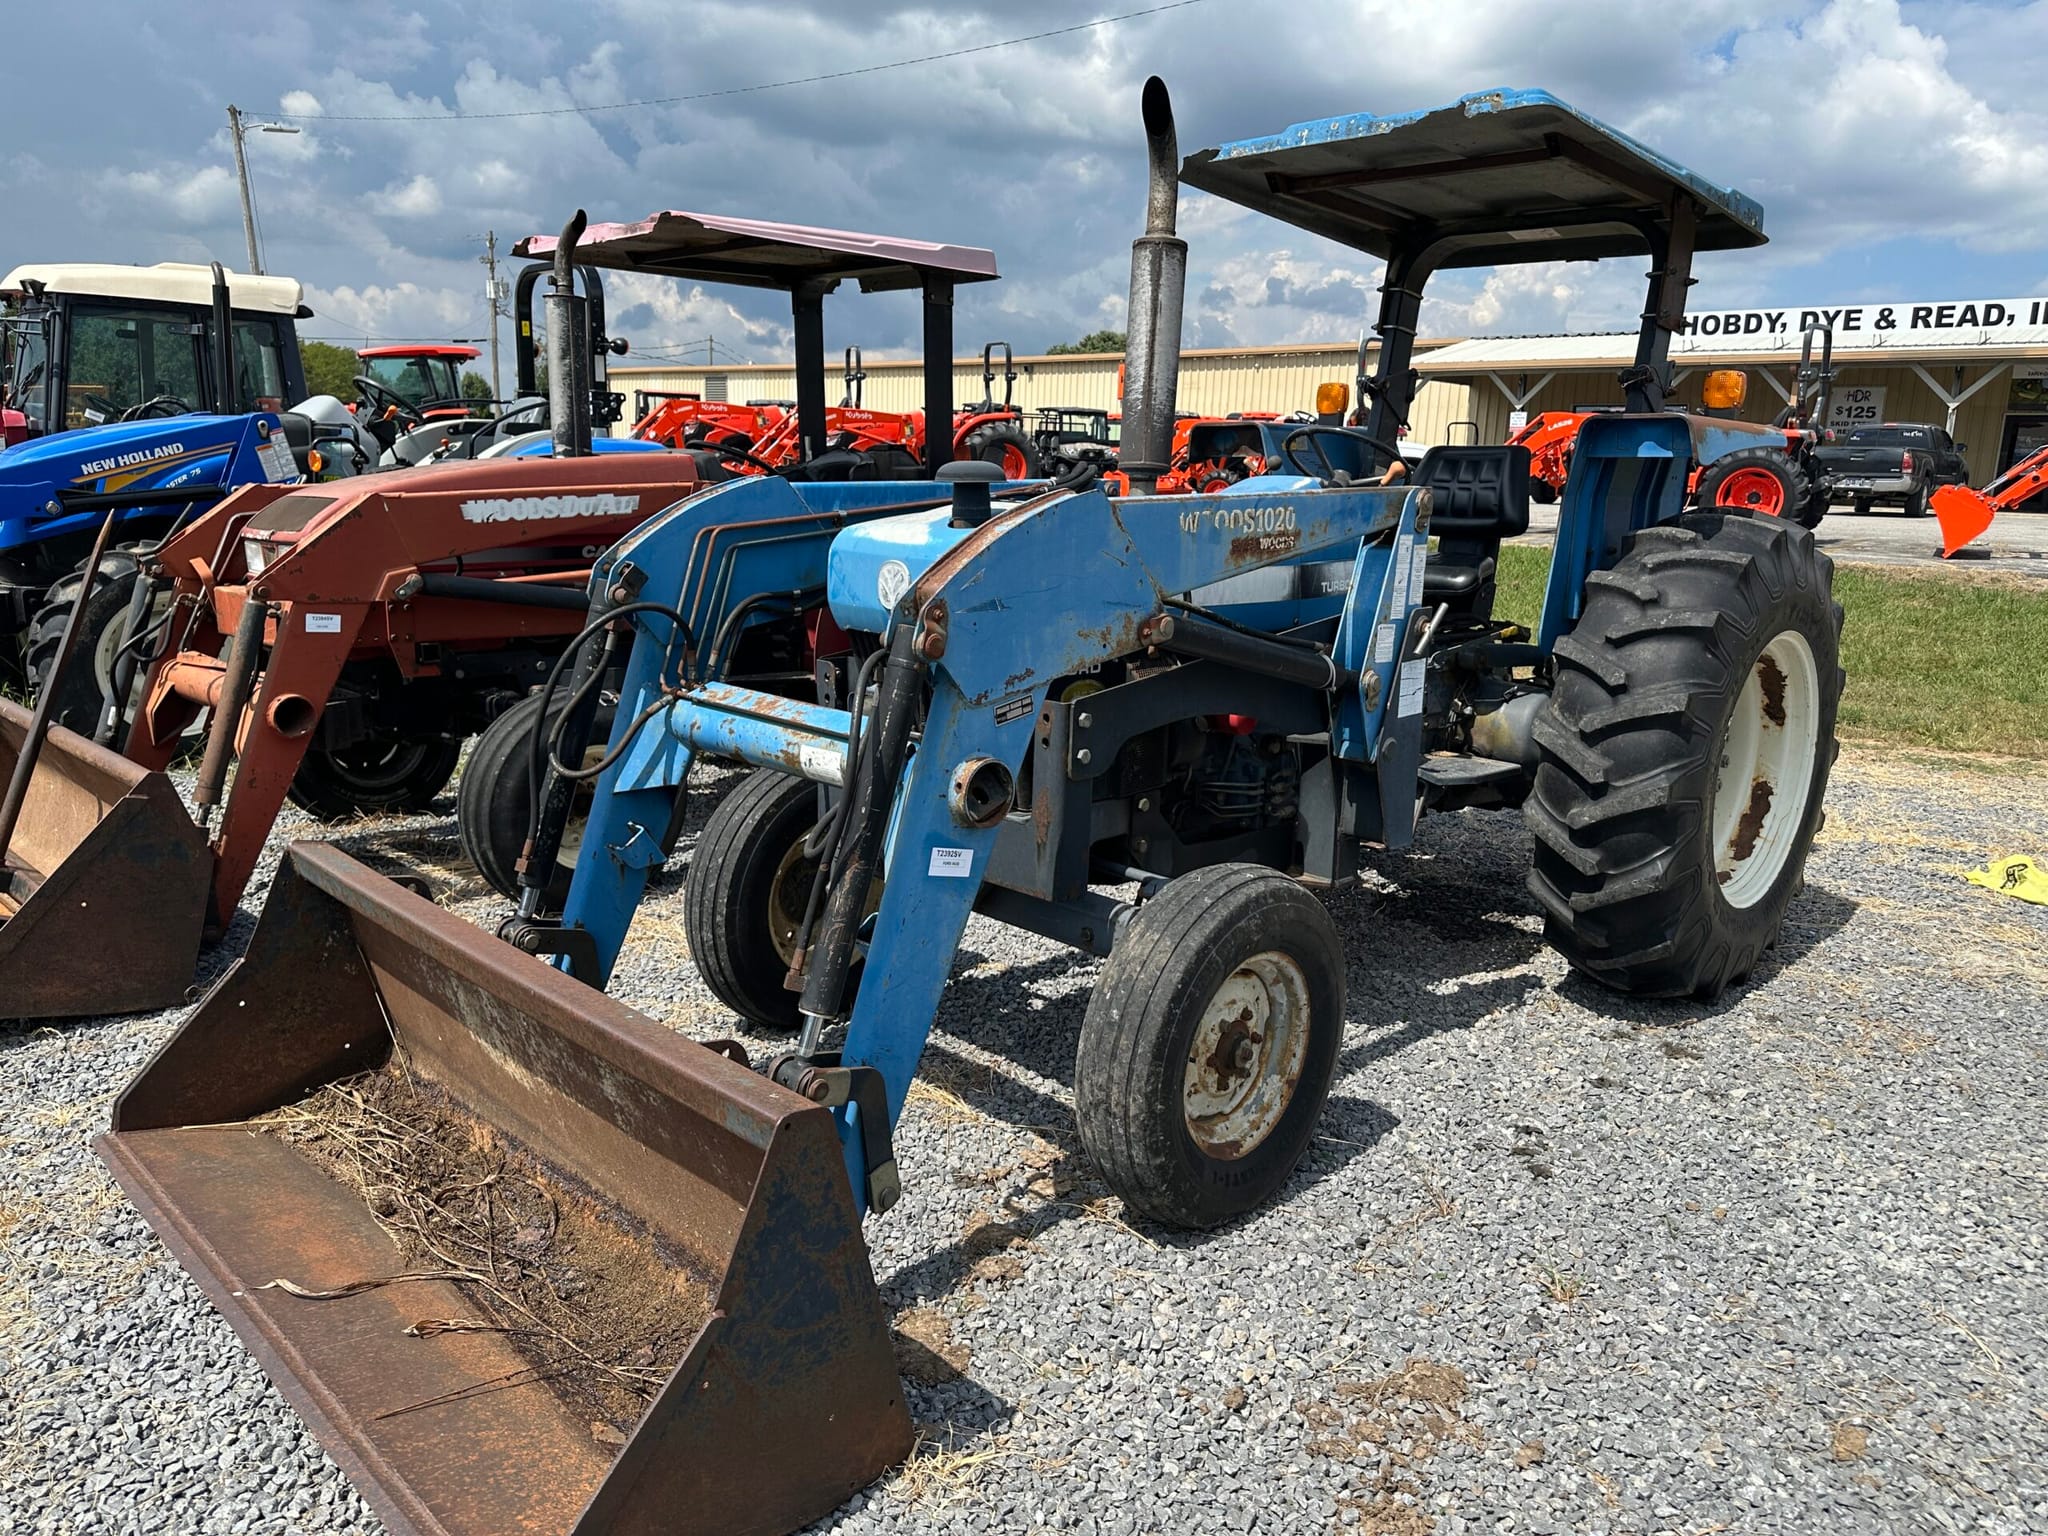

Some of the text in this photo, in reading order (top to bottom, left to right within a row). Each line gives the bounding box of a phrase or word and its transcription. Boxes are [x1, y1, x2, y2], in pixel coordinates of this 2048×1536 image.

[1680, 301, 2048, 337] HOBDY, DYE & READ, I
[845, 410, 873, 420] Kubota
[1834, 405, 1877, 419] $125
[80, 442, 184, 476] NEW HOLLAND
[165, 474, 188, 489] ASTER
[582, 545, 607, 559] CA
